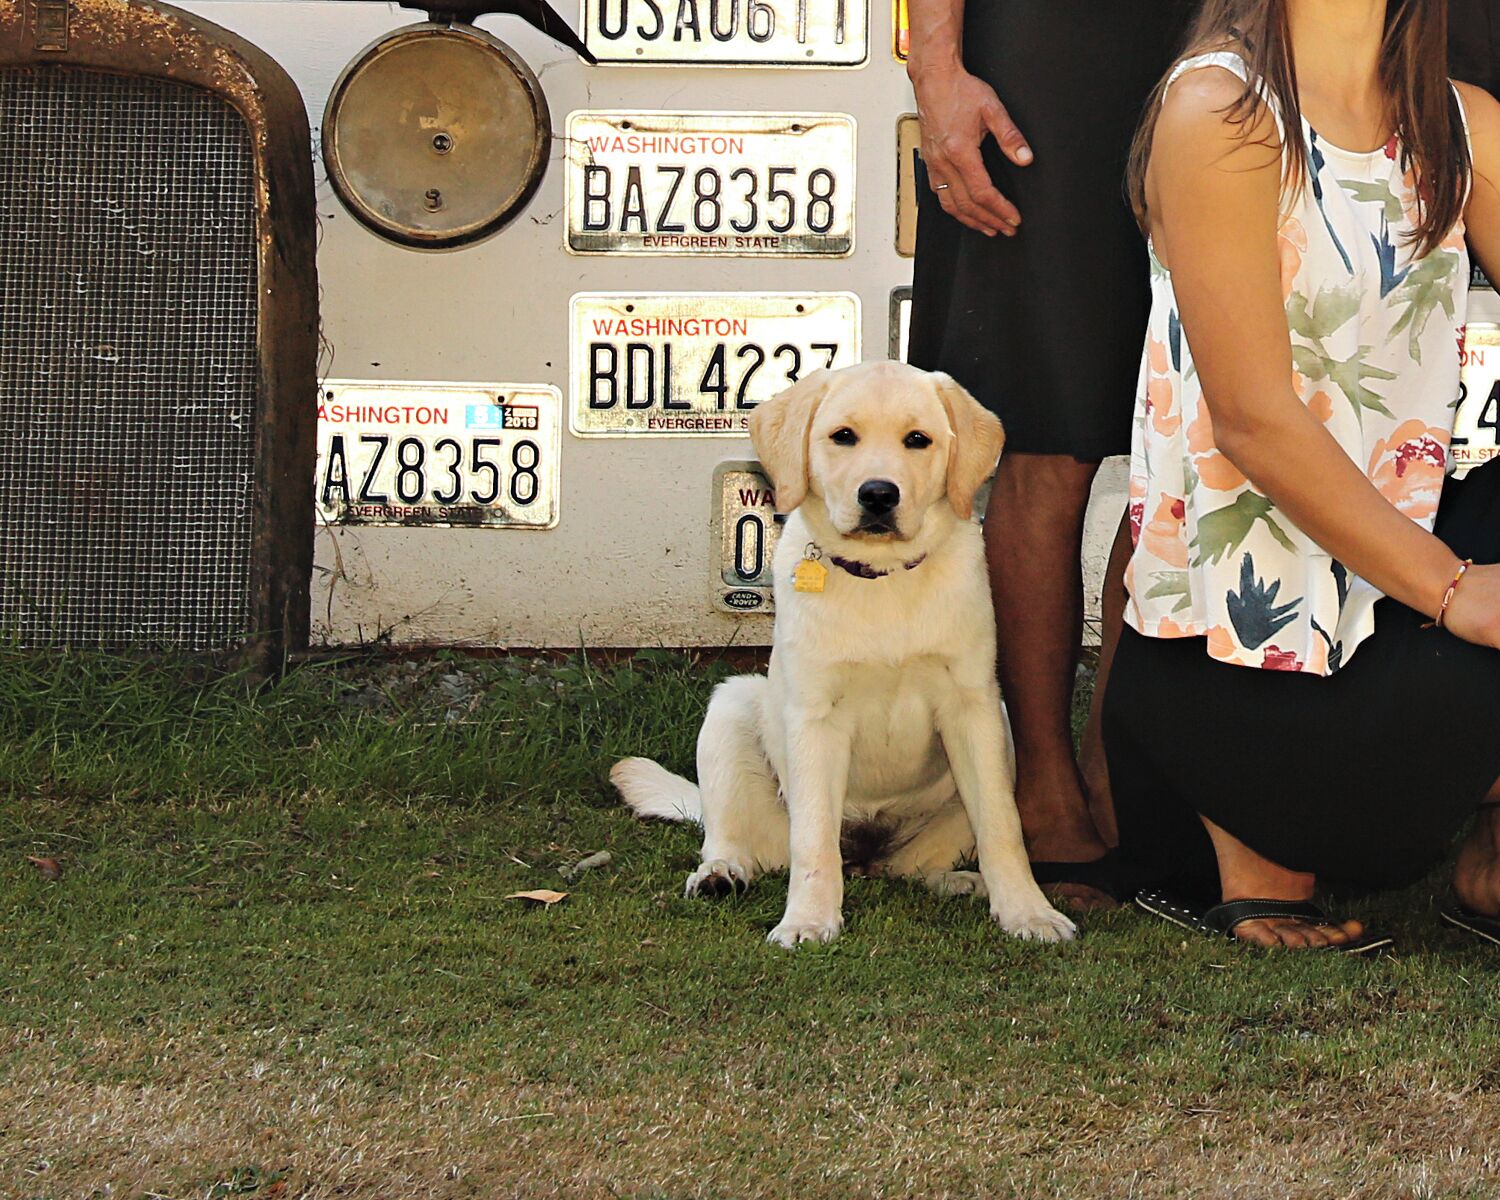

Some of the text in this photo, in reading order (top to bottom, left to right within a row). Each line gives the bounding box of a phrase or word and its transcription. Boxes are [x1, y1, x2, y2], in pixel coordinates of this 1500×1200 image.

[587, 135, 744, 155] WASHINGTON
[583, 164, 836, 234] BAZ8358
[643, 236, 780, 249] EVERGREEN STATE
[592, 318, 748, 337] WASHINGTON
[316, 405, 449, 425] ASHINGTON
[504, 416, 537, 428] 2019
[647, 418, 733, 431] EVERGREEN
[322, 435, 540, 506] AZ8358
[346, 505, 431, 518] EVERGREEN
